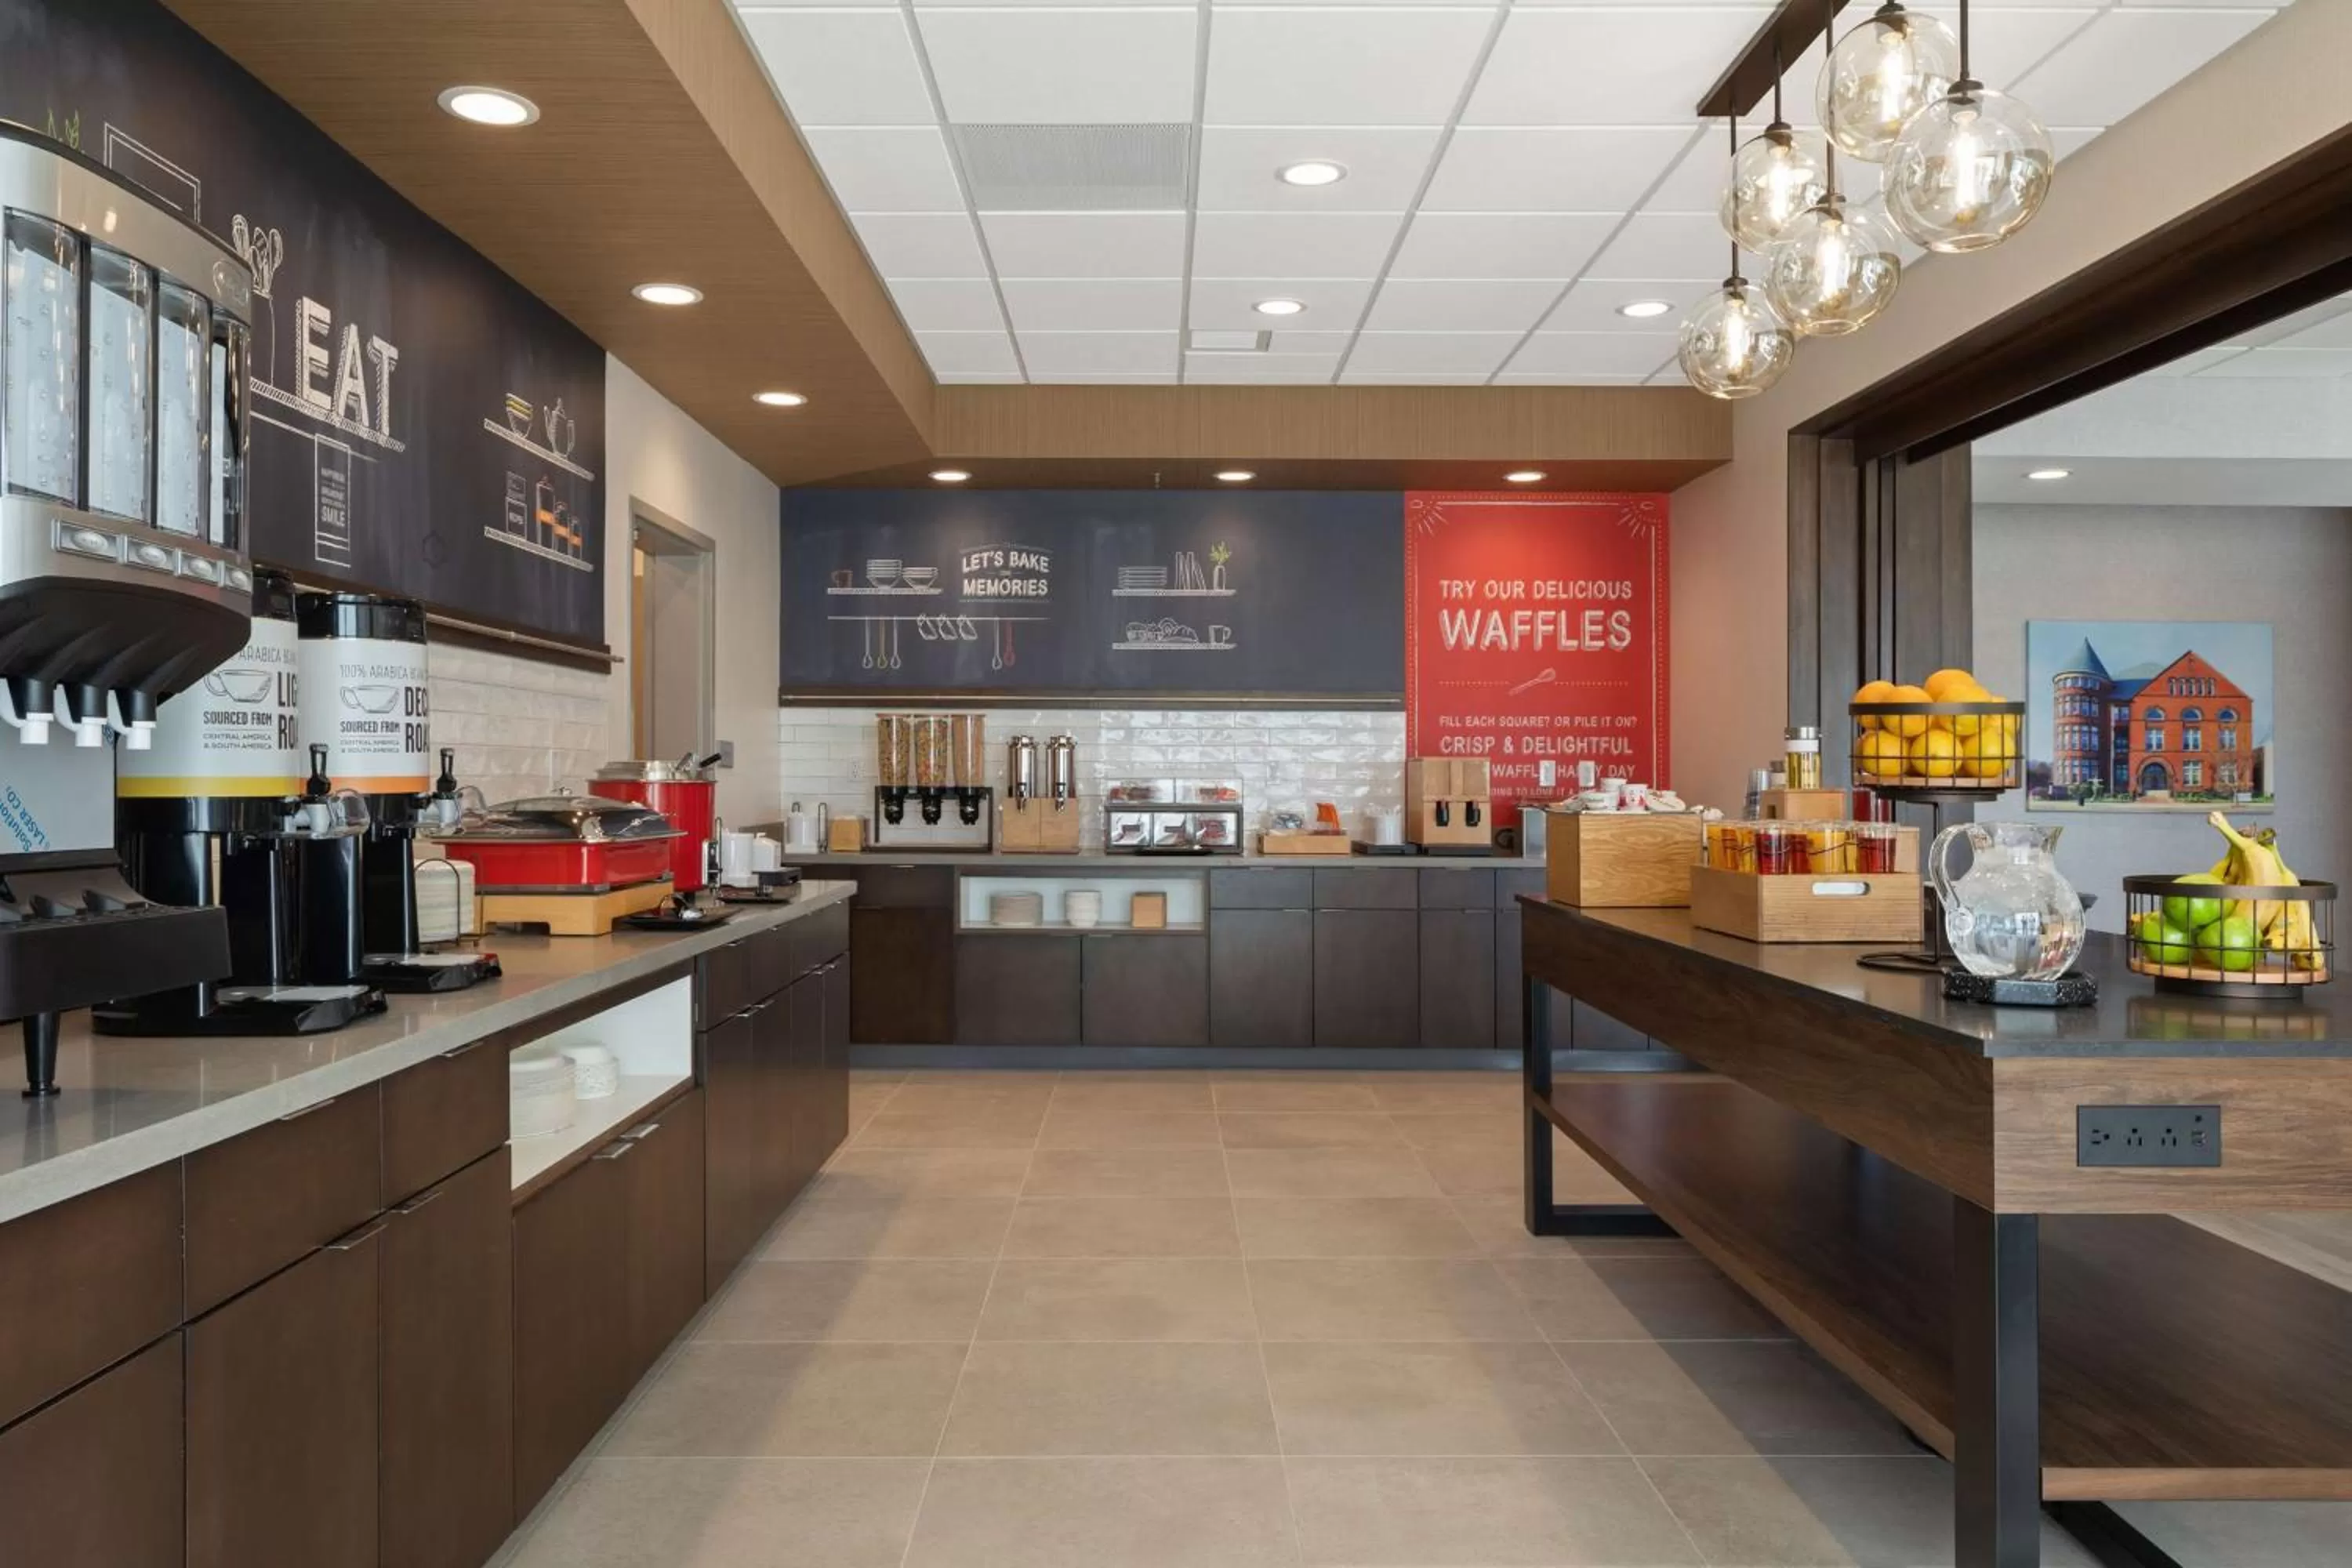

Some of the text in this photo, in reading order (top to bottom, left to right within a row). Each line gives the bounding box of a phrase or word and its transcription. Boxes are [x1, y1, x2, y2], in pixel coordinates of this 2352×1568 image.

[296, 296, 398, 437] EAT
[962, 551, 1050, 573] LET'S BAKE
[963, 578, 1048, 596] MEMORIES
[1439, 580, 1632, 600] TRY OUR DELICIOUS
[1439, 608, 1632, 652] WAFFLES
[203, 711, 272, 725] SOURCED FROM
[339, 720, 401, 733] SOURCED FROM
[1439, 716, 1638, 729] FILL EACH SQUARE? OR PILE IT ON?
[1440, 736, 1633, 755] CRISP & DELIGHTFUL
[1493, 765, 1635, 778] WAFFL HAY DAY
